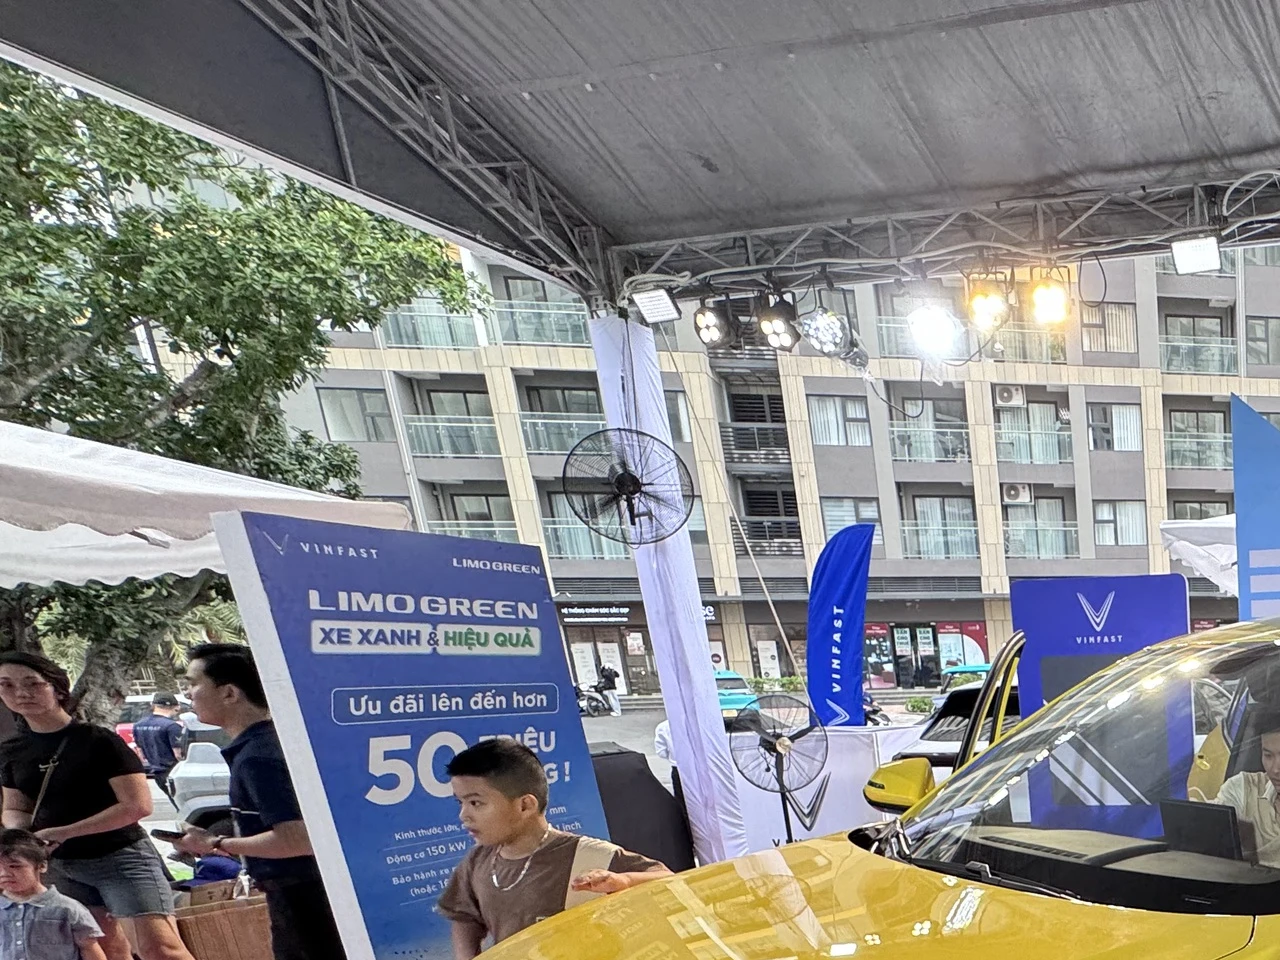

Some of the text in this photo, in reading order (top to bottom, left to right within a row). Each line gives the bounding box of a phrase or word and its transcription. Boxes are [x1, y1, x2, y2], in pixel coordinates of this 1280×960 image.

[299, 541, 379, 560] VINFAST
[319, 626, 535, 650] XE XANH & HIỆU QUẢ
[1075, 634, 1123, 645] VINFAST
[831, 605, 845, 693] VINFAST
[350, 689, 547, 716] Ưu đãi lên đến hơn
[549, 806, 567, 815] mm
[394, 829, 416, 841] Kính
[417, 826, 443, 837] thước
[414, 851, 426, 859] cơ
[426, 844, 447, 857] 150
[448, 841, 467, 853] kW
[392, 873, 412, 885] Bảo
[413, 869, 437, 881] hành
